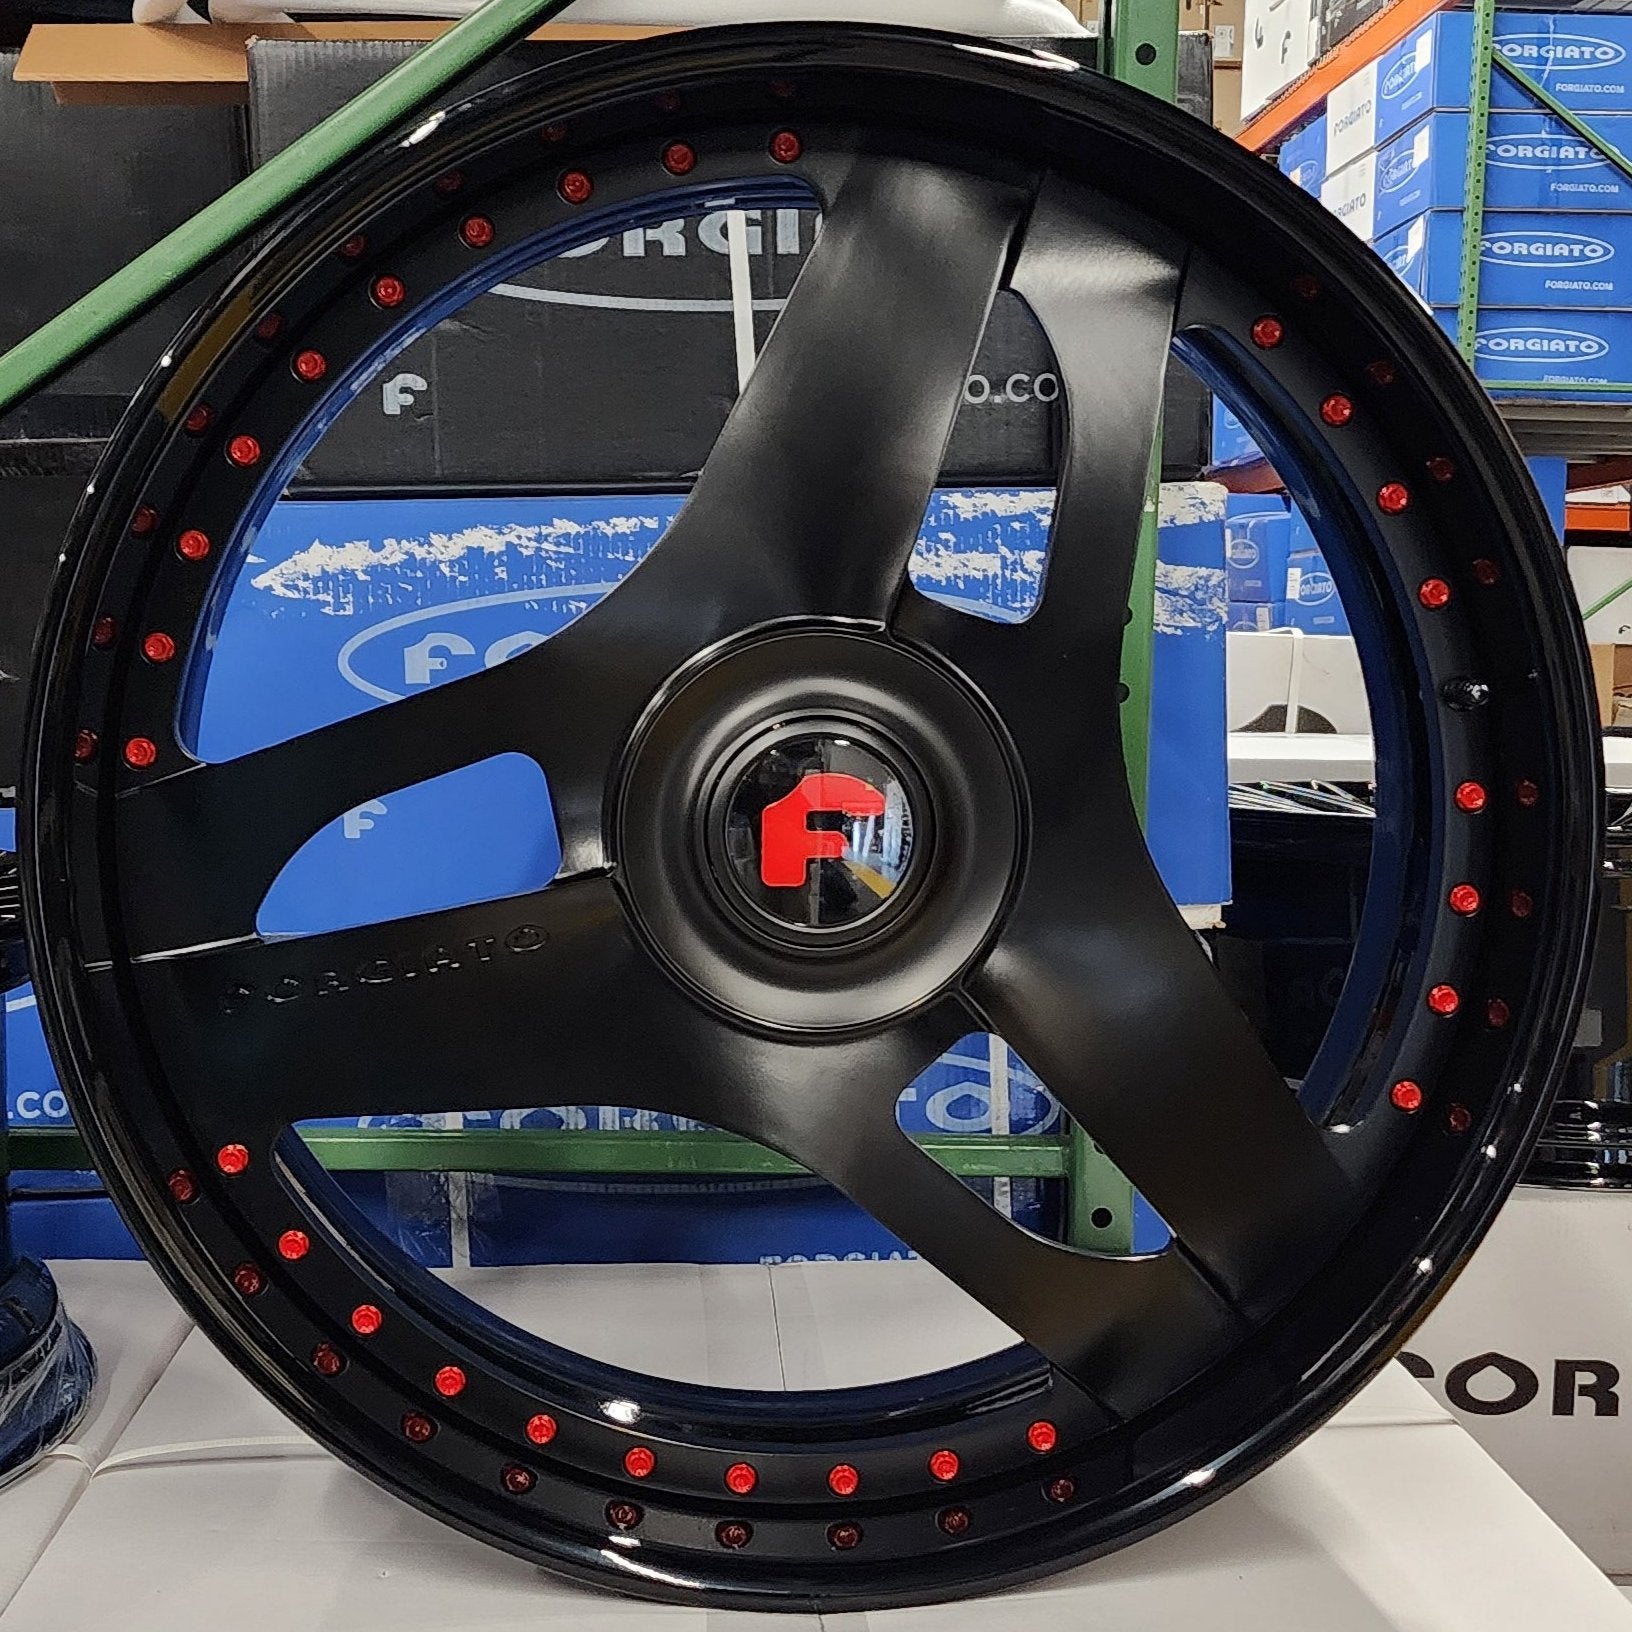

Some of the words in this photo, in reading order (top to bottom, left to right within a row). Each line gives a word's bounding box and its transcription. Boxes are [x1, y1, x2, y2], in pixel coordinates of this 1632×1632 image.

[1555, 82, 1625, 94] FORGIATO.COM
[1550, 182, 1619, 193] FORGIATO.COM
[1544, 279, 1614, 291] FORGIATO.COM
[382, 373, 428, 416] F
[343, 799, 388, 839] F
[761, 772, 886, 887] F
